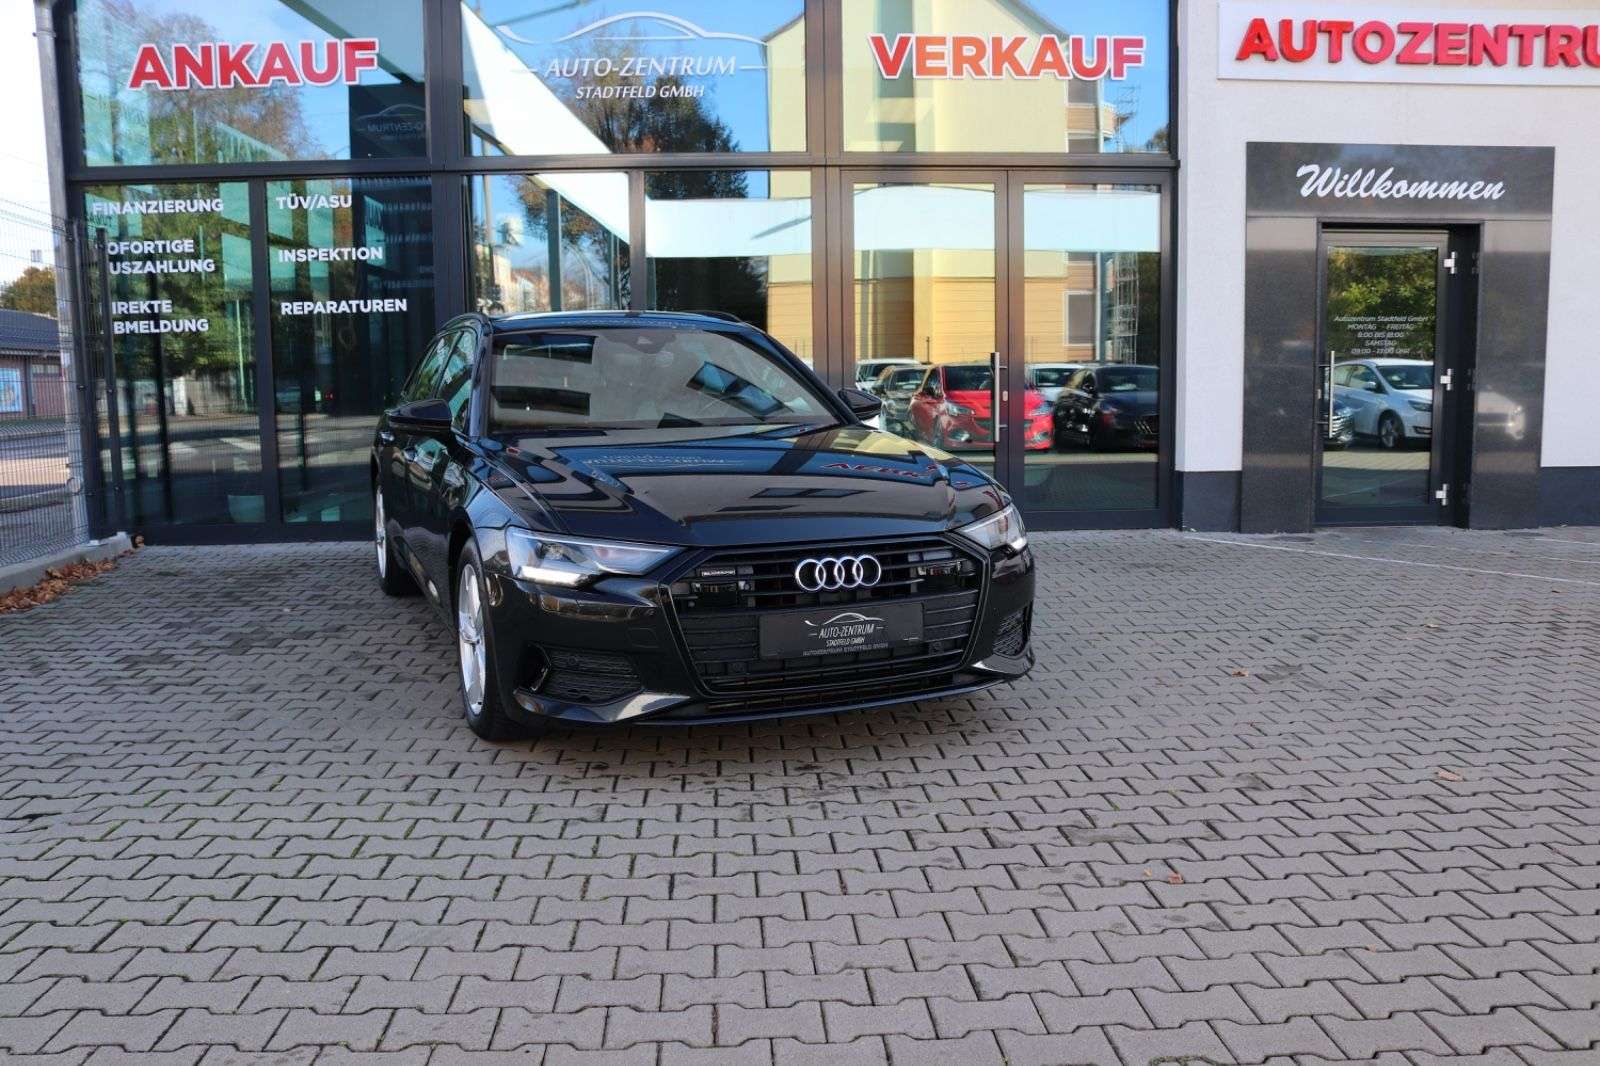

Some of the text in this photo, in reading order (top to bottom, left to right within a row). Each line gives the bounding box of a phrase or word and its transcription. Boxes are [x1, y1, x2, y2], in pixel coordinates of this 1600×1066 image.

[128, 37, 379, 91] ANKAUF
[869, 33, 1145, 80] VERKAUF
[544, 55, 736, 78] AUTO-ZENTRUM
[576, 85, 705, 100] STADTFELD GMBH
[1296, 164, 1505, 200] Willkommen
[92, 199, 224, 215] FINANZIERUNG
[276, 194, 352, 210] TÜV/ASU
[107, 239, 194, 255] OFORTIGE
[278, 247, 383, 263] INSPEKTION
[110, 259, 215, 274] USZAHLUNG
[112, 300, 172, 314] IREKTE
[281, 298, 407, 315] REPARATUREN
[114, 318, 209, 335] BMELDUNG
[818, 623, 875, 639] AUTO-ZENTRUM
